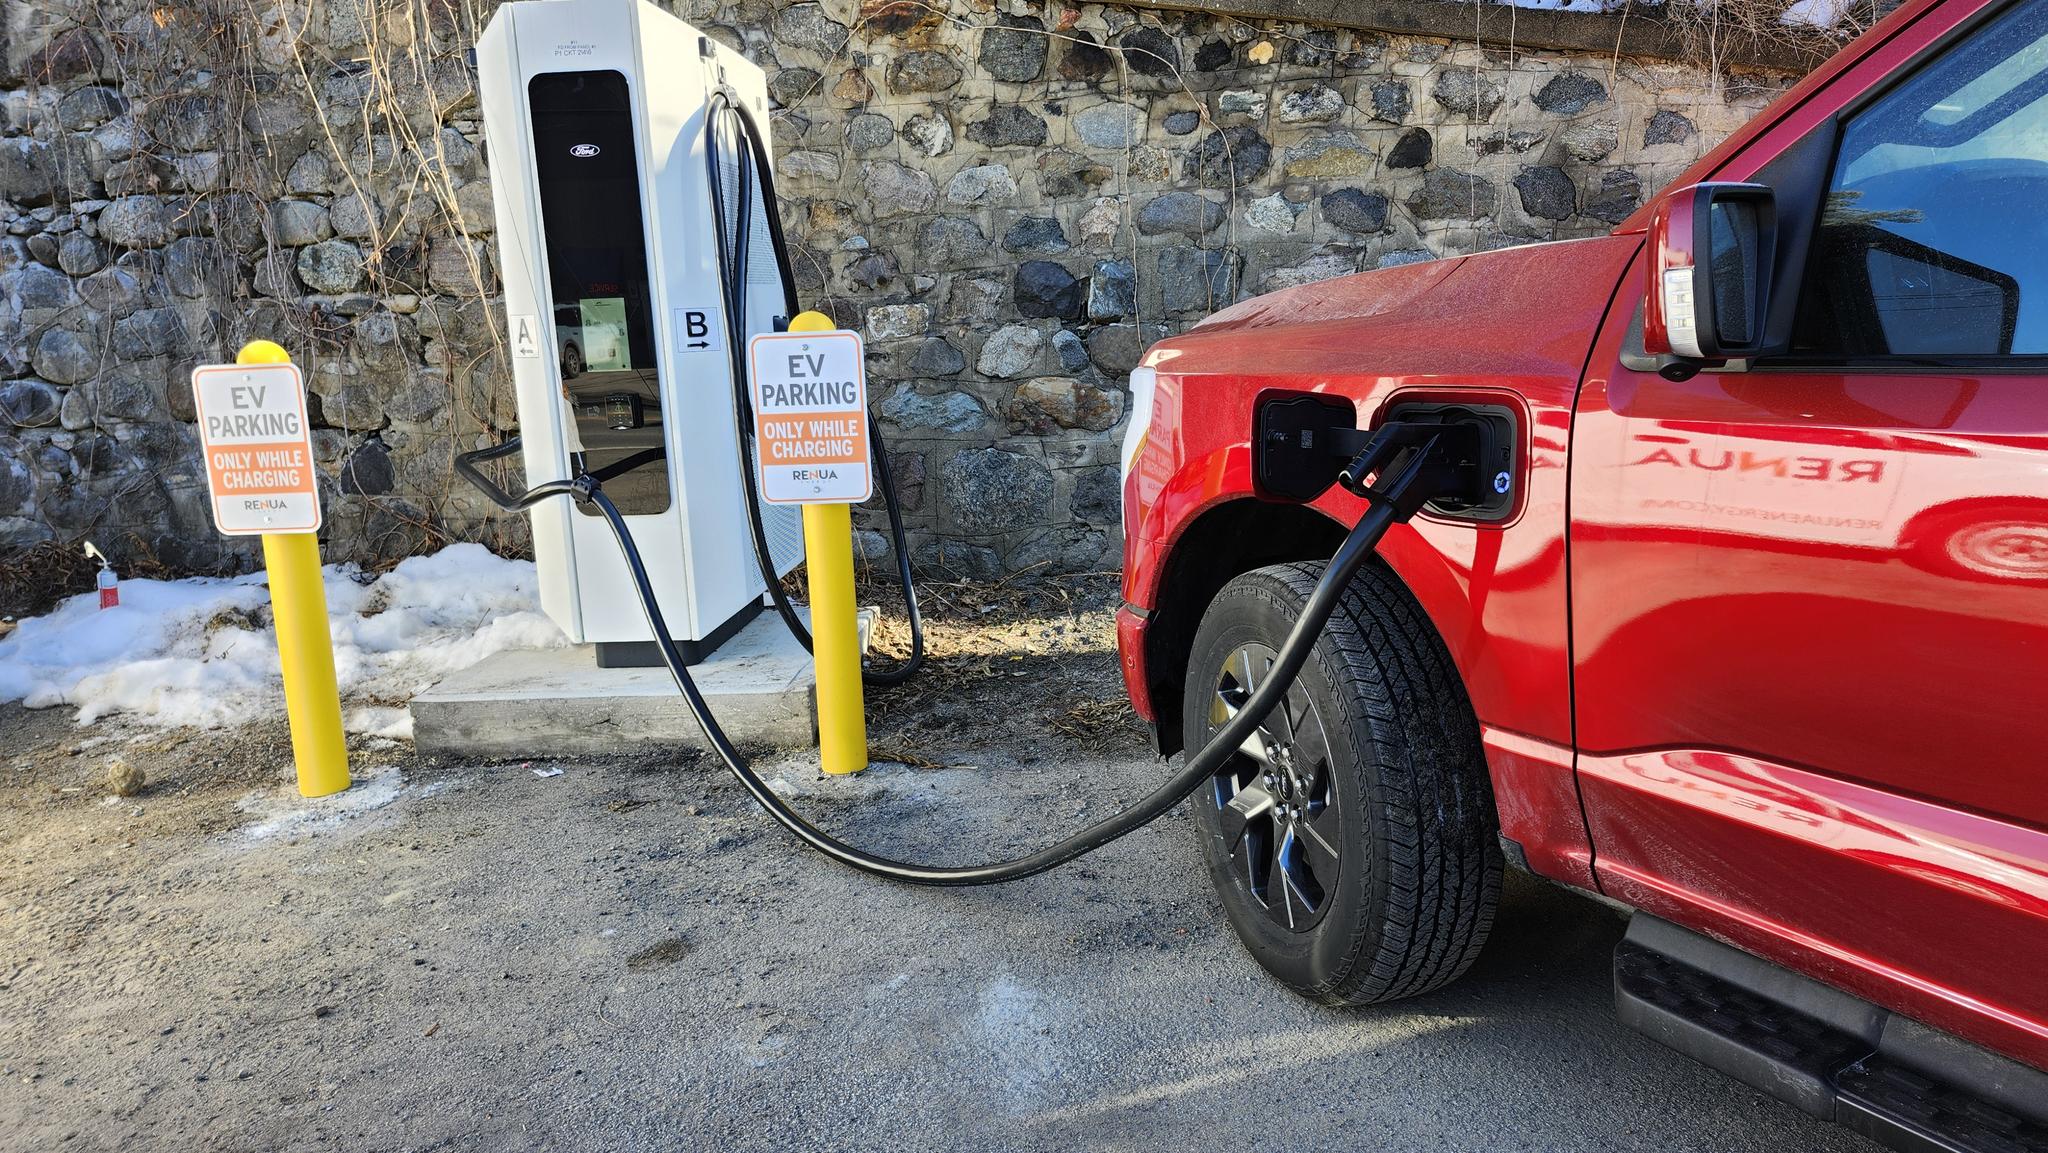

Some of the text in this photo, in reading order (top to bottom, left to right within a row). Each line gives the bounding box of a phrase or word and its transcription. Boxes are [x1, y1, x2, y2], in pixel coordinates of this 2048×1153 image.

[518, 318, 532, 345] A
[685, 311, 709, 338] B
[788, 353, 825, 378] EV
[231, 385, 266, 409] EV
[761, 381, 857, 407] PARKING
[208, 412, 299, 438] PARKING
[764, 419, 859, 439] ONLY WHILE
[213, 450, 304, 470] ONLY WHILE
[772, 439, 854, 459] CHARGING
[223, 470, 301, 489] CHARGING
[793, 470, 838, 480] RENUA
[244, 500, 287, 511] RENUA
